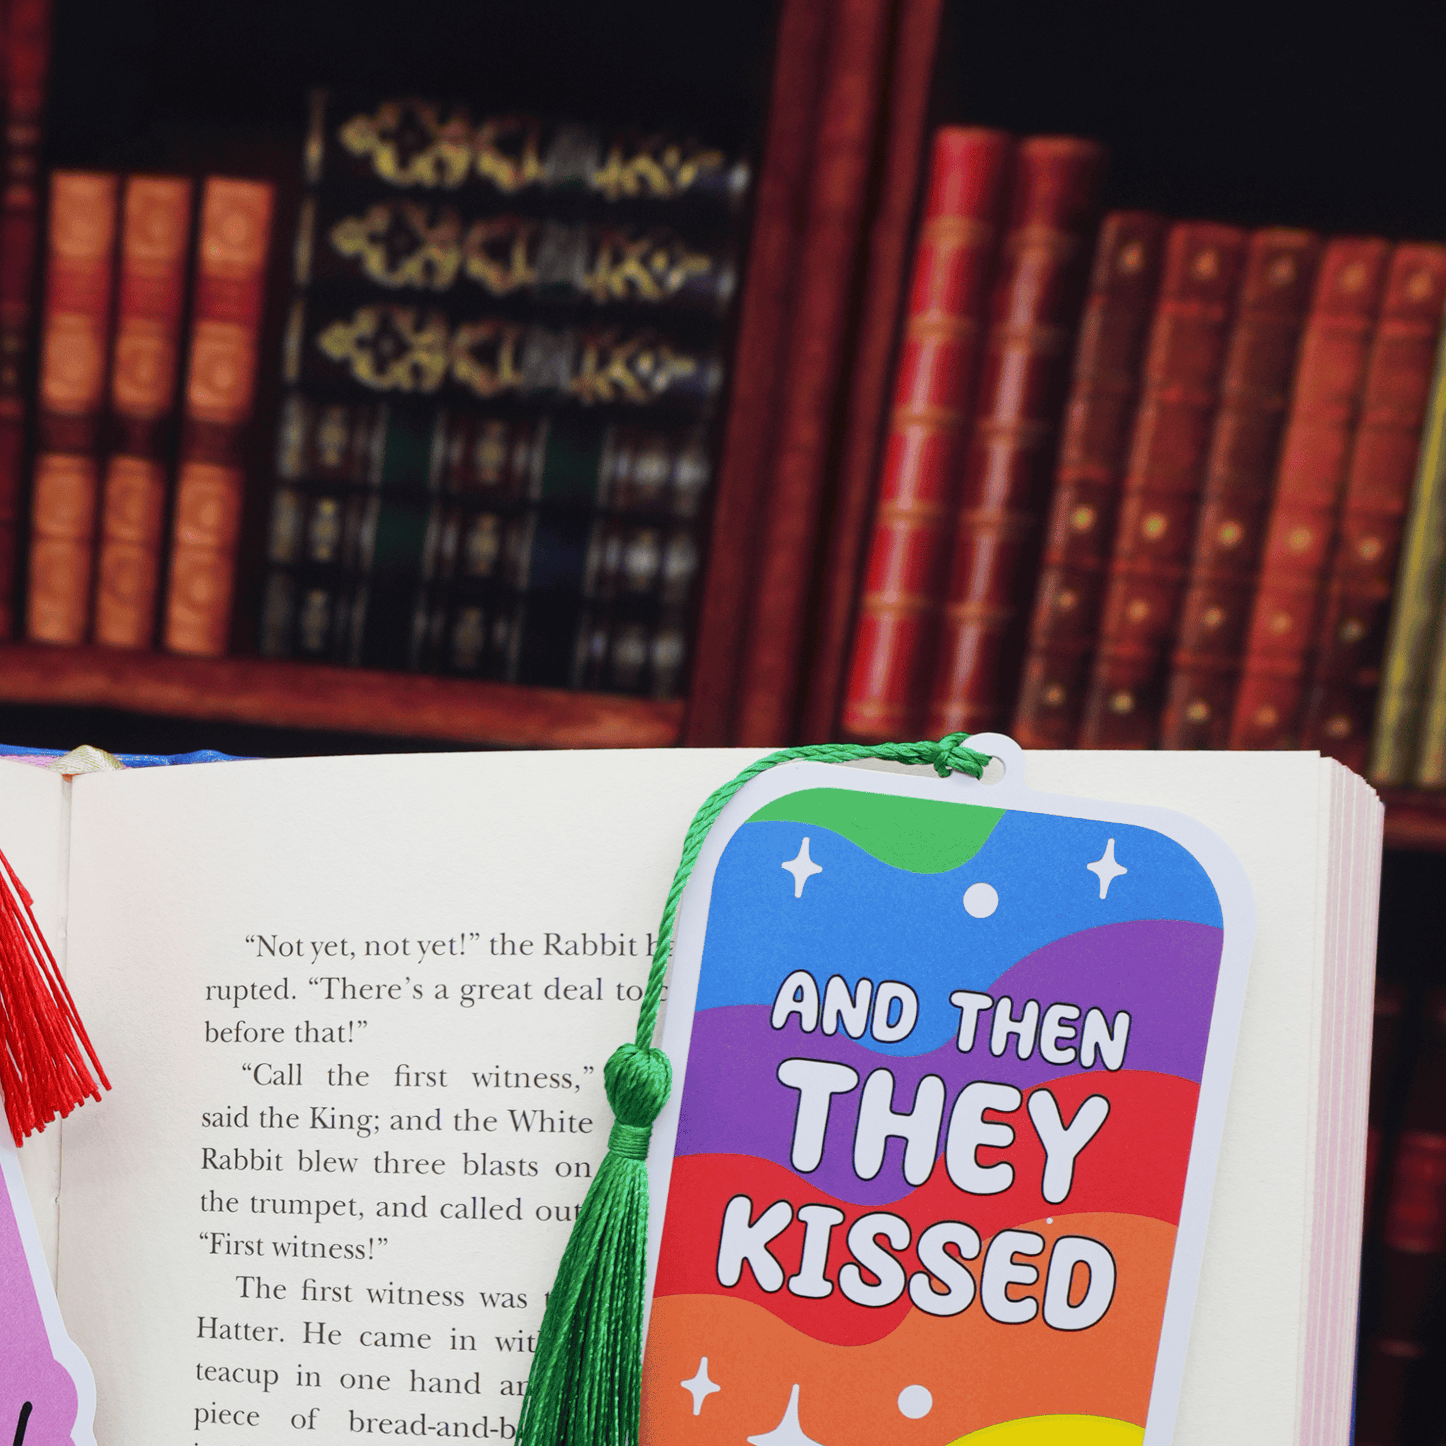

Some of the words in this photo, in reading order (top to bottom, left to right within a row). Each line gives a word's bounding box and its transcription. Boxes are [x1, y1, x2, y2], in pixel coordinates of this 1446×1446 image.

[245, 934, 305, 958] “Not
[310, 938, 356, 965] yet,
[364, 937, 411, 957] not
[416, 932, 481, 965] yet!”
[489, 932, 534, 956] the
[543, 932, 639, 957] Rabbit
[205, 976, 297, 1009] rupted.
[308, 976, 424, 1000] “There’s
[434, 983, 450, 1000] a
[459, 981, 533, 1009] great
[543, 976, 604, 1001] deal
[770, 969, 918, 1044] AND
[949, 989, 1131, 1071] THEN
[241, 1062, 303, 1086] “Call
[327, 1063, 370, 1087] the
[394, 1063, 448, 1088] first
[471, 1064, 595, 1094] witness,”
[777, 1057, 1111, 1204] THEY
[199, 1231, 265, 1257] “First
[271, 1234, 389, 1261] witness!”
[716, 1194, 1117, 1332] KISSED
[195, 1362, 279, 1394] teacup
[296, 1364, 323, 1389] in
[339, 1373, 391, 1391] one
[409, 1368, 482, 1395] hand
